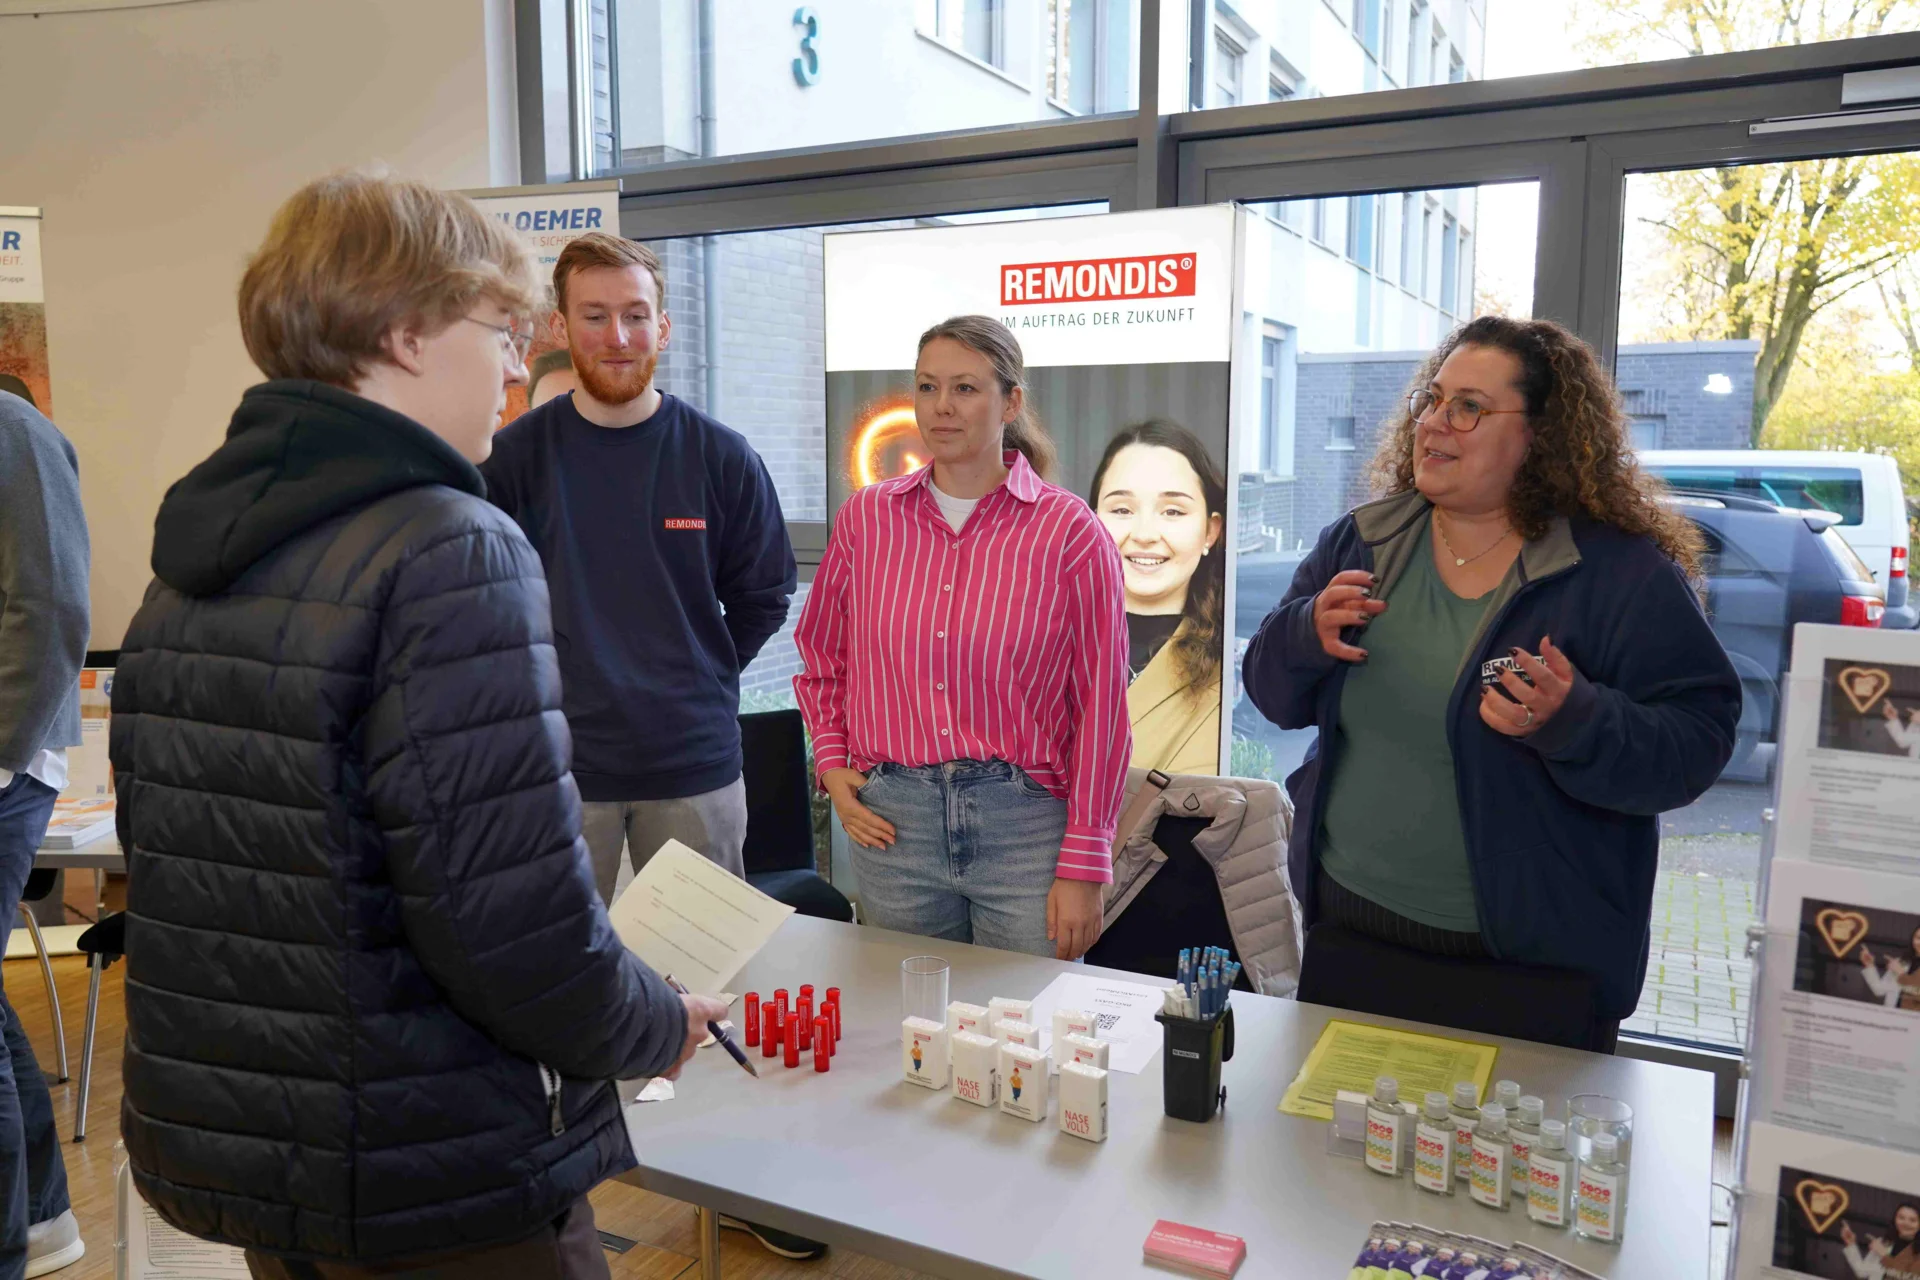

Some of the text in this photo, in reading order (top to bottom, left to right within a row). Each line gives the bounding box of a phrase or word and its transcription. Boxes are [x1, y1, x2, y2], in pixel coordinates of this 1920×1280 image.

[792, 6, 819, 88] 3
[1022, 313, 1086, 329] AUFTRAG
[1093, 311, 1120, 326] DER
[1127, 307, 1195, 324] ZUKUNFT
[957, 1076, 980, 1091] NASE
[957, 1086, 980, 1100] VOLL?
[1064, 1109, 1089, 1125] NASE
[1065, 1119, 1090, 1135] VOLL?
